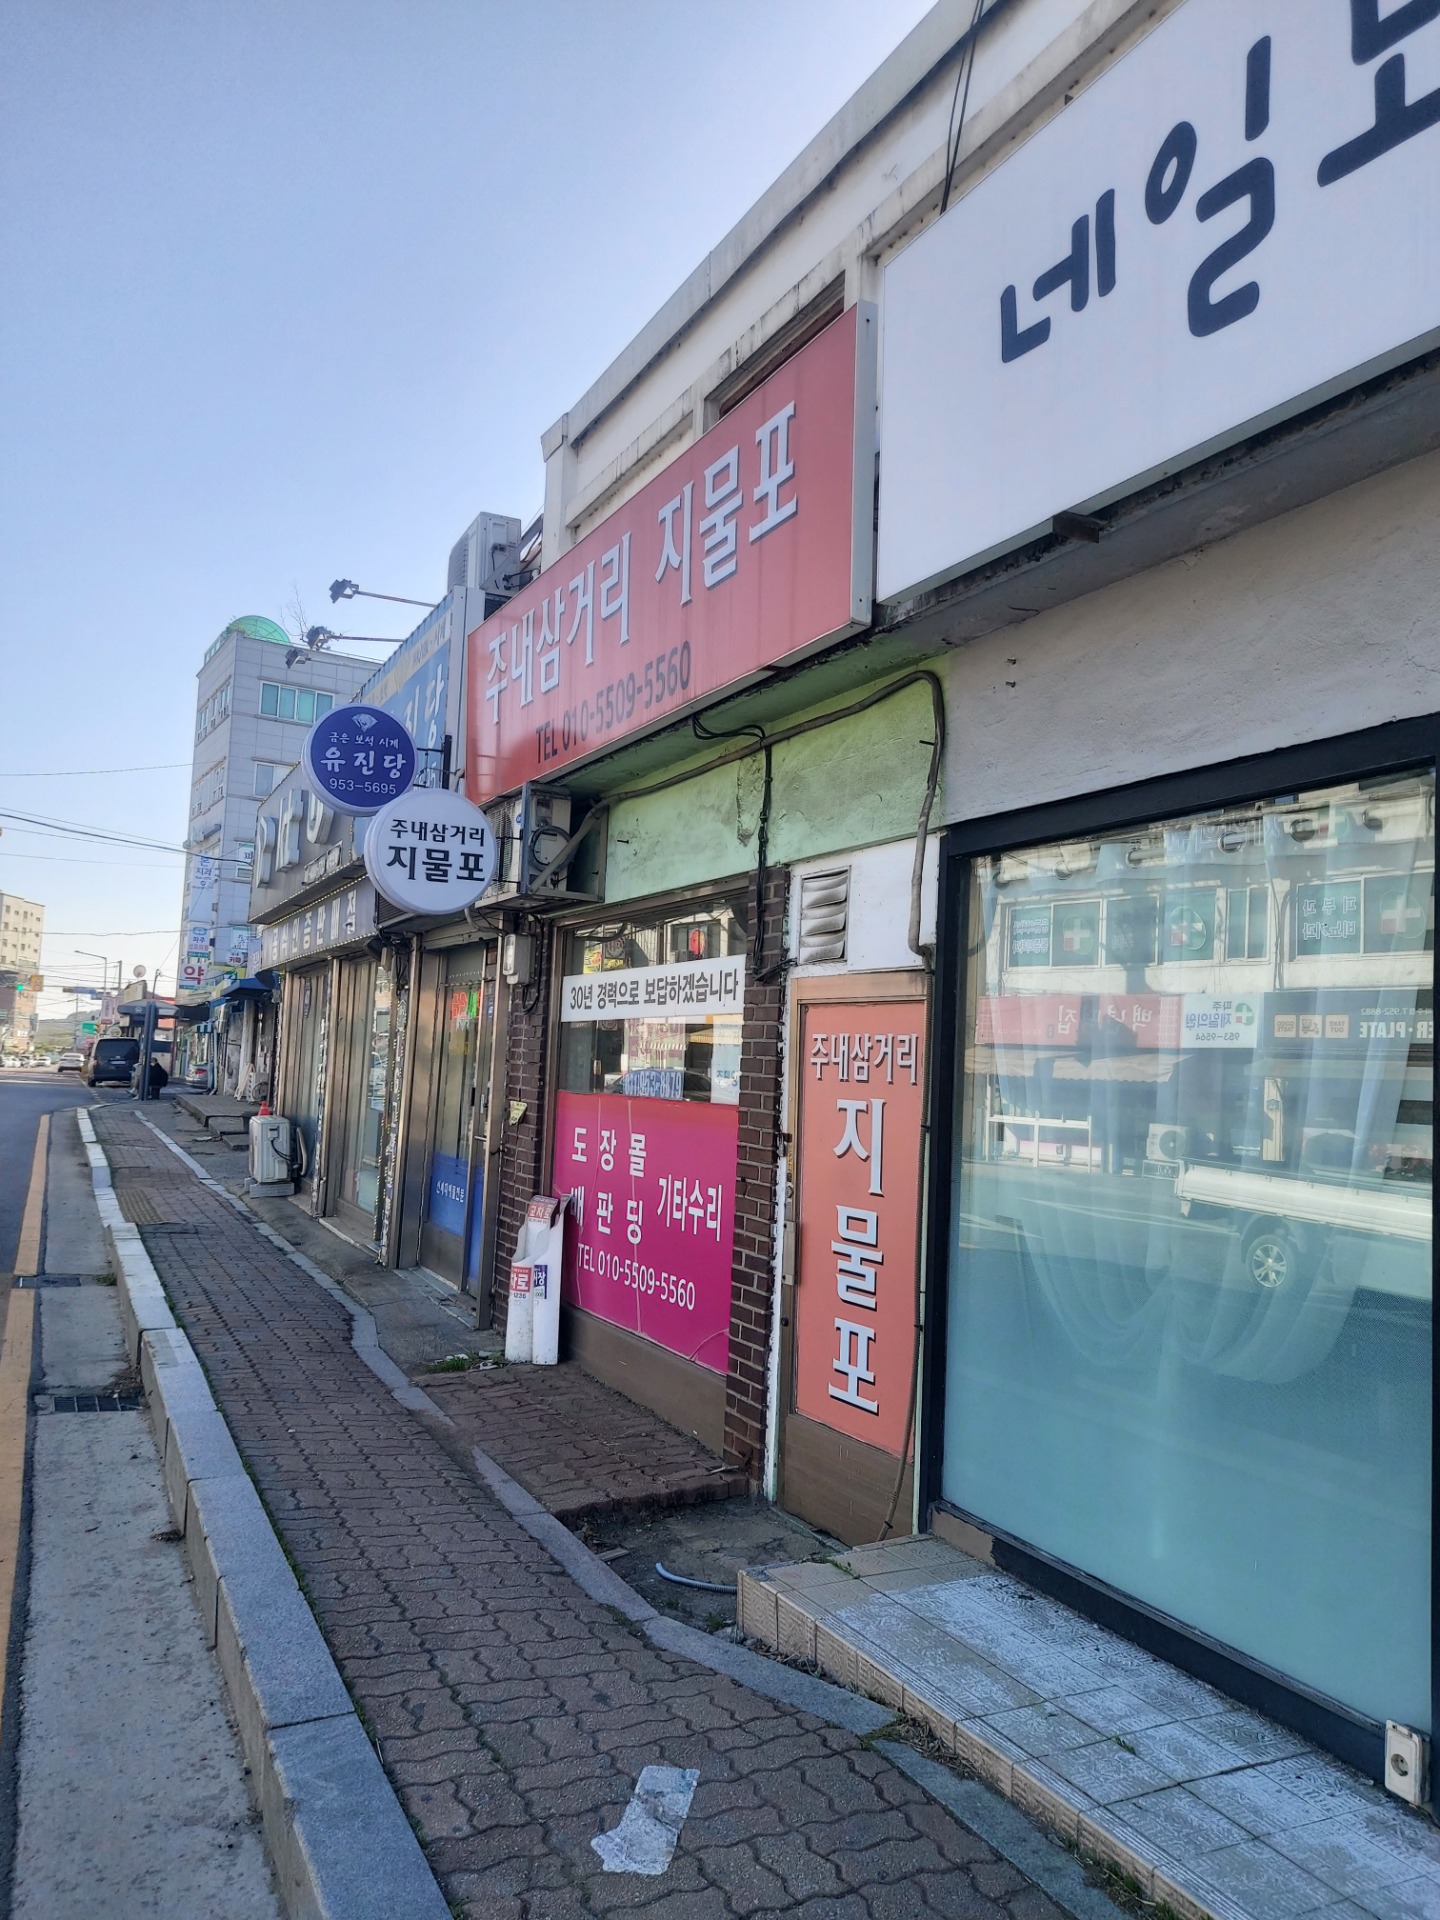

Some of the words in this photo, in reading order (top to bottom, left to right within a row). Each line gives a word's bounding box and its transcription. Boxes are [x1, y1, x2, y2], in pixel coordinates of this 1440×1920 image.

[486, 531, 631, 724] 주내삼거리
[655, 400, 798, 606] 지물포
[536, 721, 558, 764] TEL
[562, 641, 692, 746] 010-5509-5560
[328, 732, 350, 743] 금은
[354, 734, 375, 747] 보석
[378, 737, 400, 749] 시계
[320, 747, 407, 779] 유진당
[329, 778, 397, 795] 953-5695
[390, 819, 486, 847] 주내삼거리
[386, 845, 486, 883] 지물포
[184, 966, 205, 985] 약
[570, 984, 593, 1010] 30년
[597, 980, 640, 1010] 경력으로
[644, 968, 739, 1006] 보답하겠습니다
[810, 1033, 919, 1084] 주내삼거리
[657, 1174, 722, 1242] 기타수리
[577, 1243, 595, 1272] TEL
[598, 1250, 695, 1311] 010-5509-5560
[828, 1097, 886, 1416] 지물포
